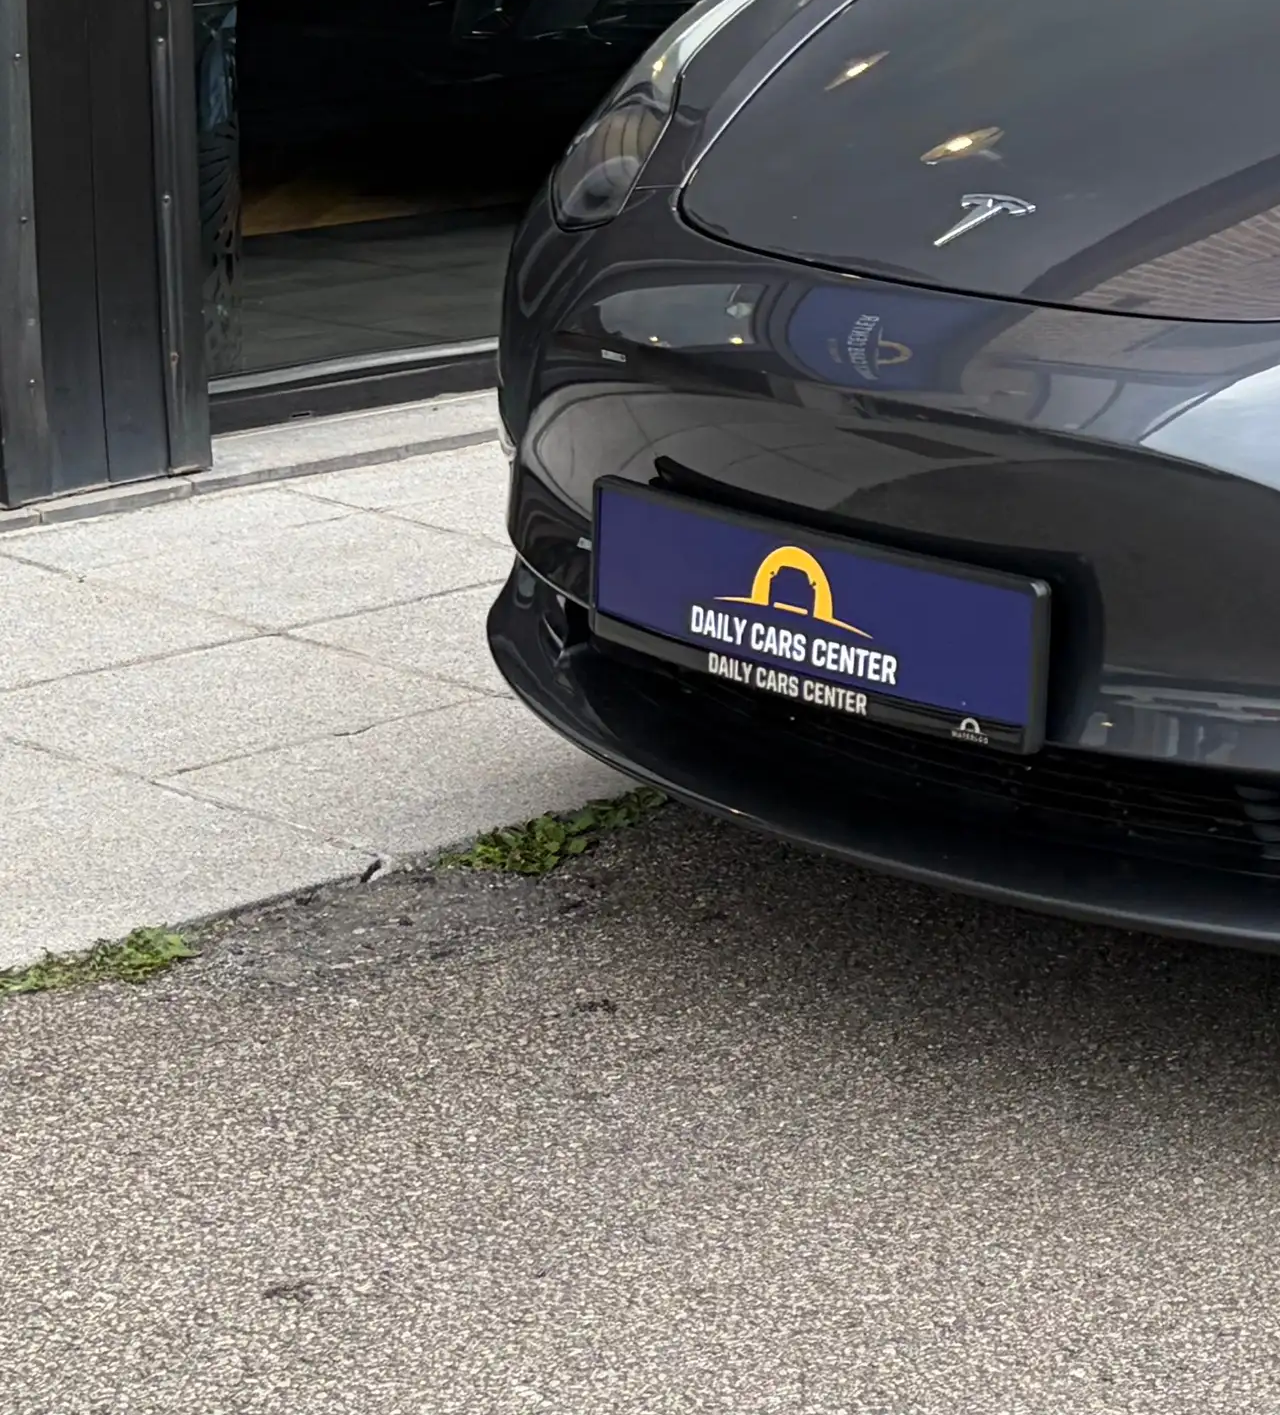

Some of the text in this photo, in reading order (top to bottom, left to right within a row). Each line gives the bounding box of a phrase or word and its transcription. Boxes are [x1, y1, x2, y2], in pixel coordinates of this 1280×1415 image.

[690, 604, 898, 686] DAILY CARS CENTER
[708, 651, 868, 716] DAILY CARS CENTER
